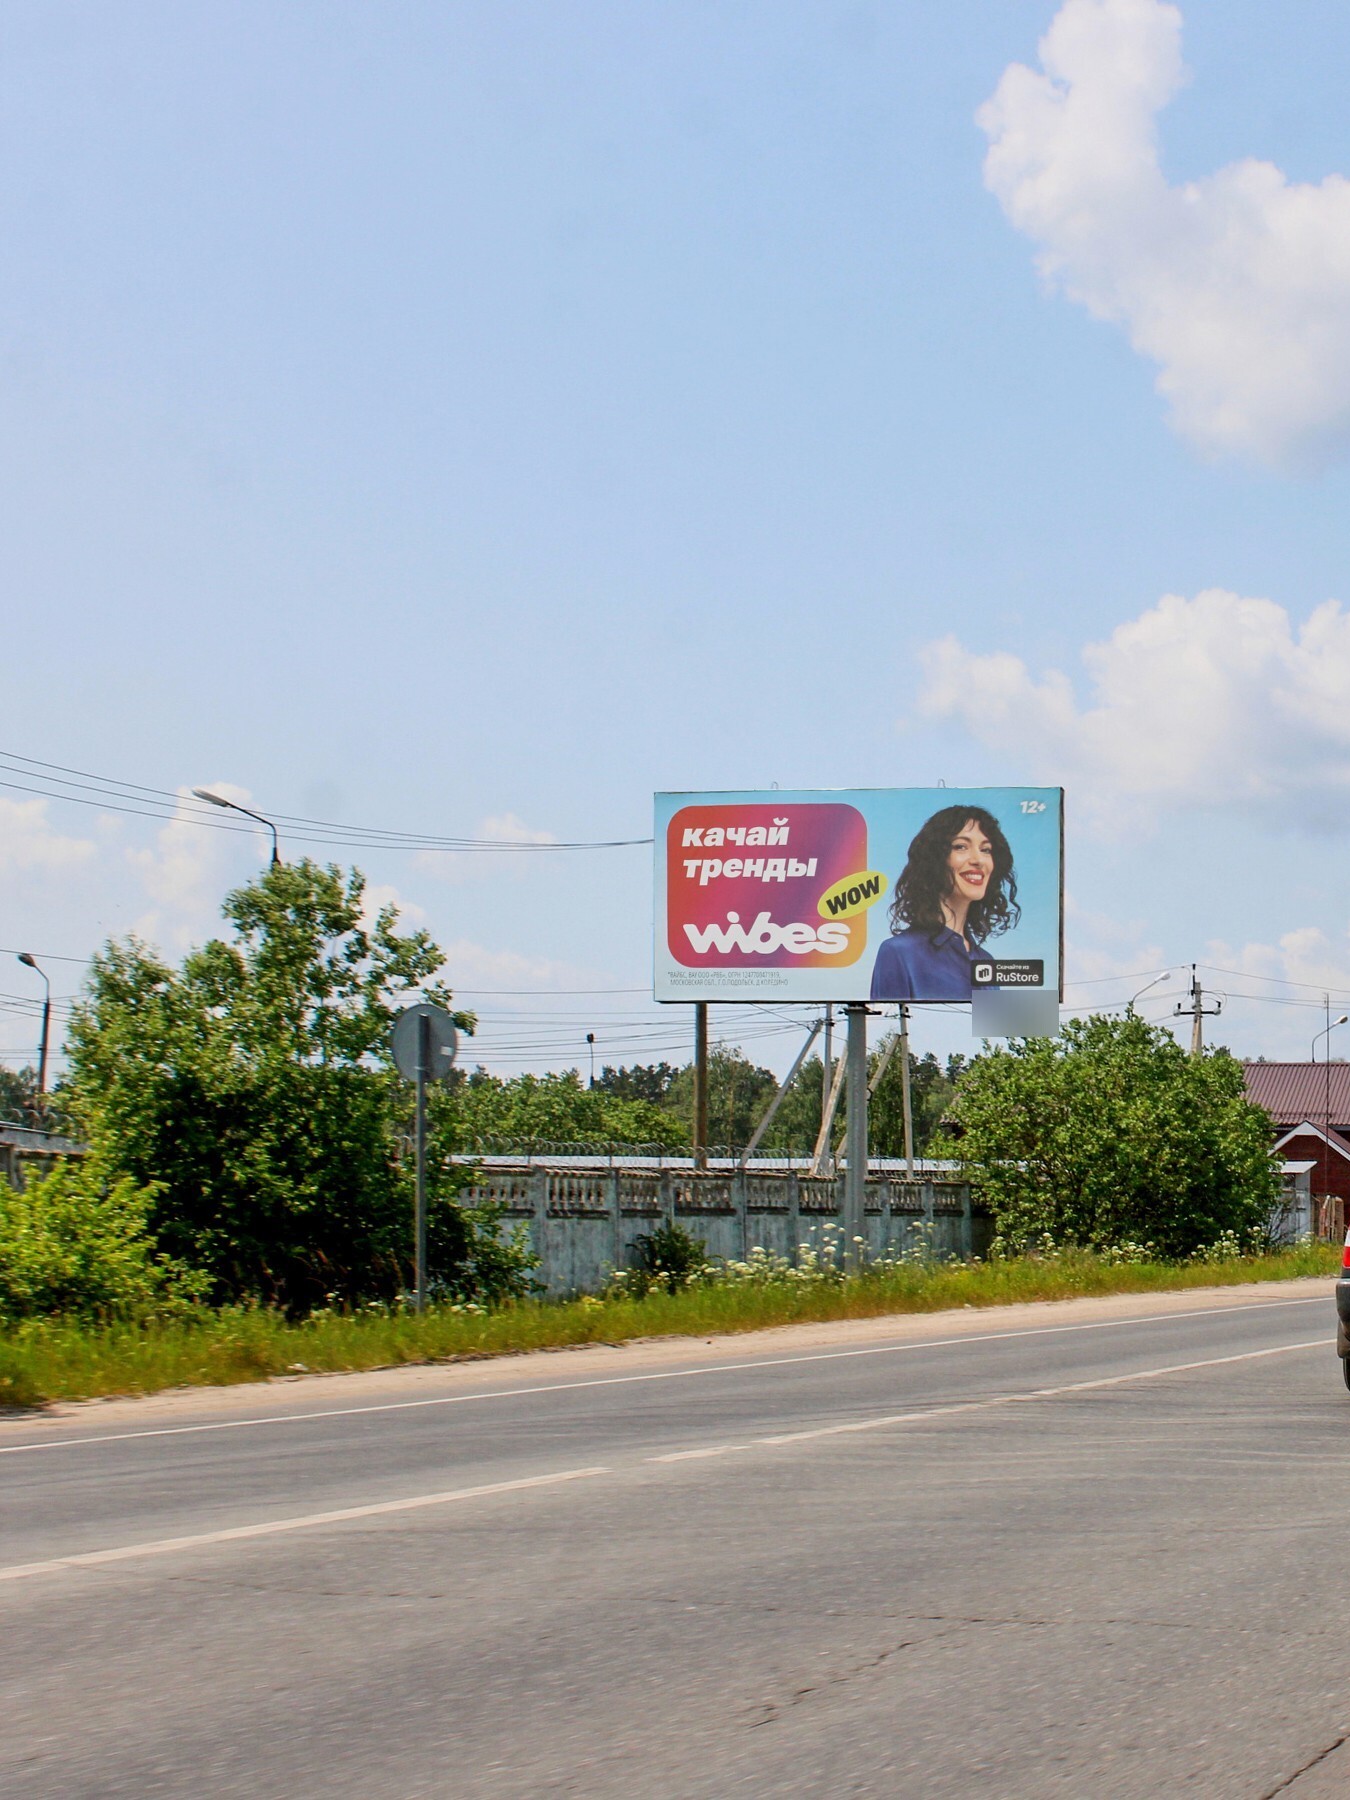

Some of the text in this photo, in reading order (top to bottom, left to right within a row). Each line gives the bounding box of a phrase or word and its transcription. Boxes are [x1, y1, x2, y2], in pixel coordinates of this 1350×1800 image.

[1020, 800, 1046, 814] 12+
[681, 817, 790, 847] качай
[683, 857, 818, 886] тренды
[825, 875, 880, 915] WOW
[682, 911, 851, 954] wibes
[996, 972, 1040, 982] RuStore
